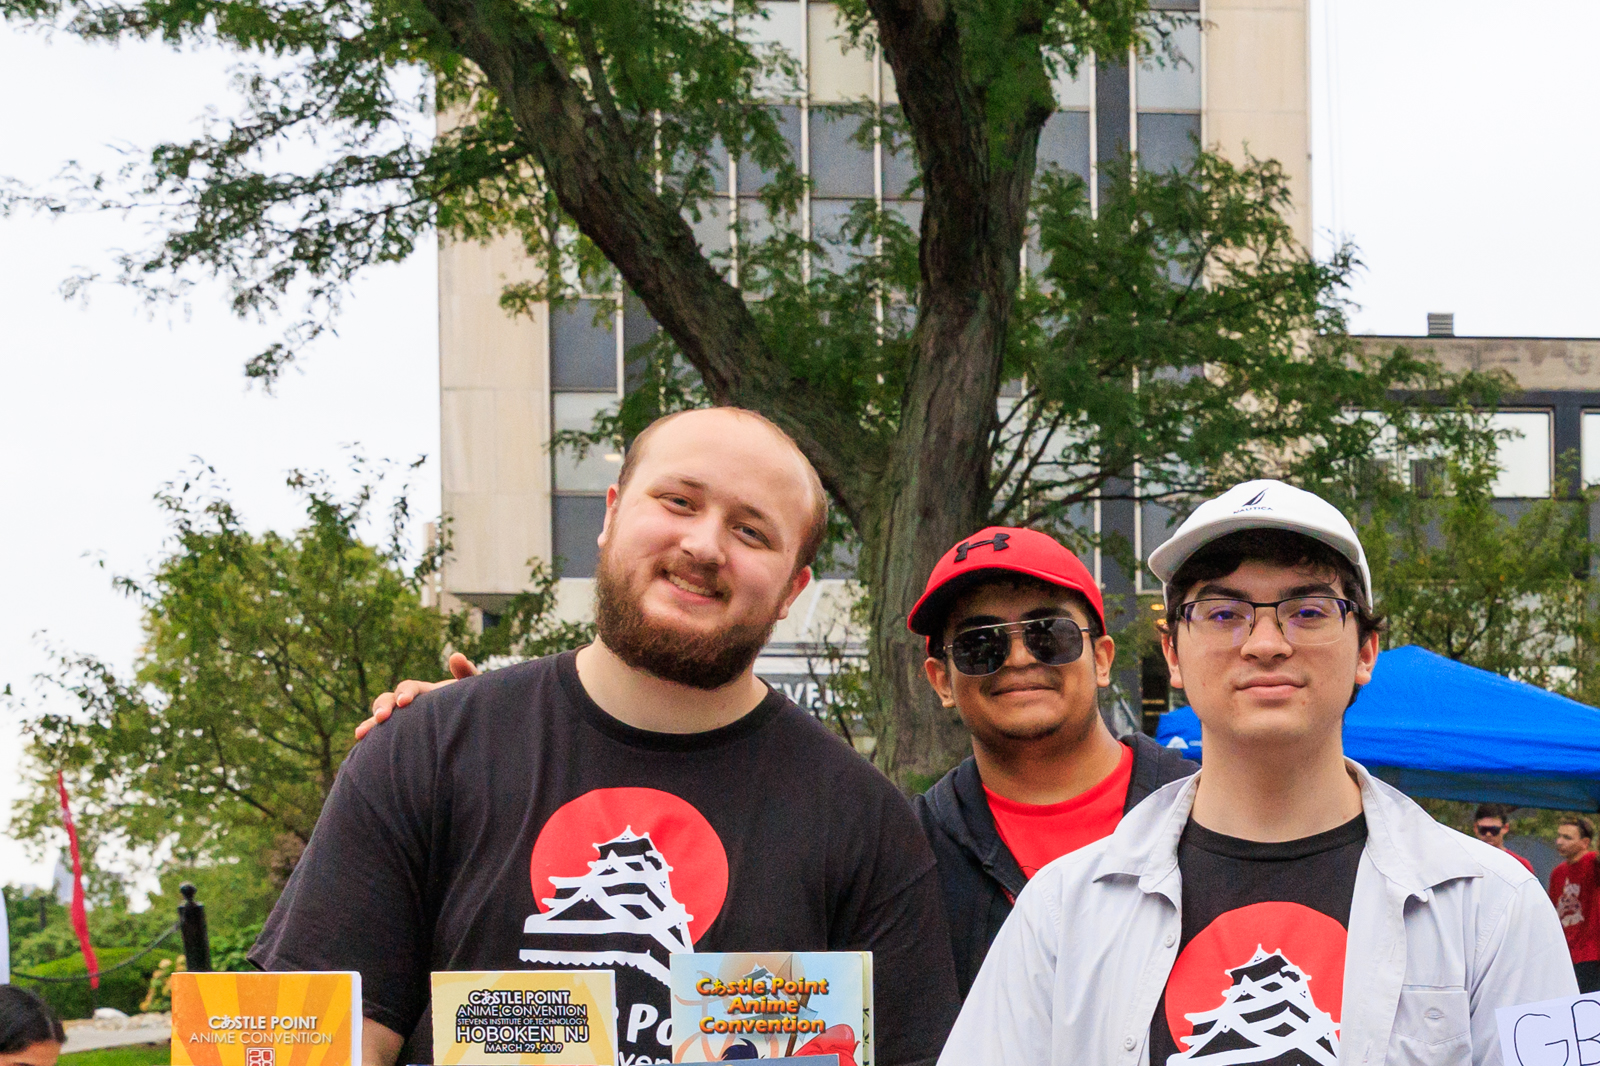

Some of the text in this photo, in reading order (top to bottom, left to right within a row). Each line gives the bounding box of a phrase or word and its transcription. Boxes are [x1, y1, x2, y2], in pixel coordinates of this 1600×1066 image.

[771, 977, 829, 996] Point
[526, 991, 570, 1004] POINT
[457, 1005, 586, 1016] ANIME CONVENTION
[727, 998, 799, 1014] Anime
[271, 1016, 317, 1029] POINT
[699, 1017, 826, 1034] Convention
[189, 1032, 332, 1044] ANIME CONVENTION
[457, 1026, 588, 1042] HOBOKEN NJ
[485, 1043, 563, 1053] MARCH 29, 2009
